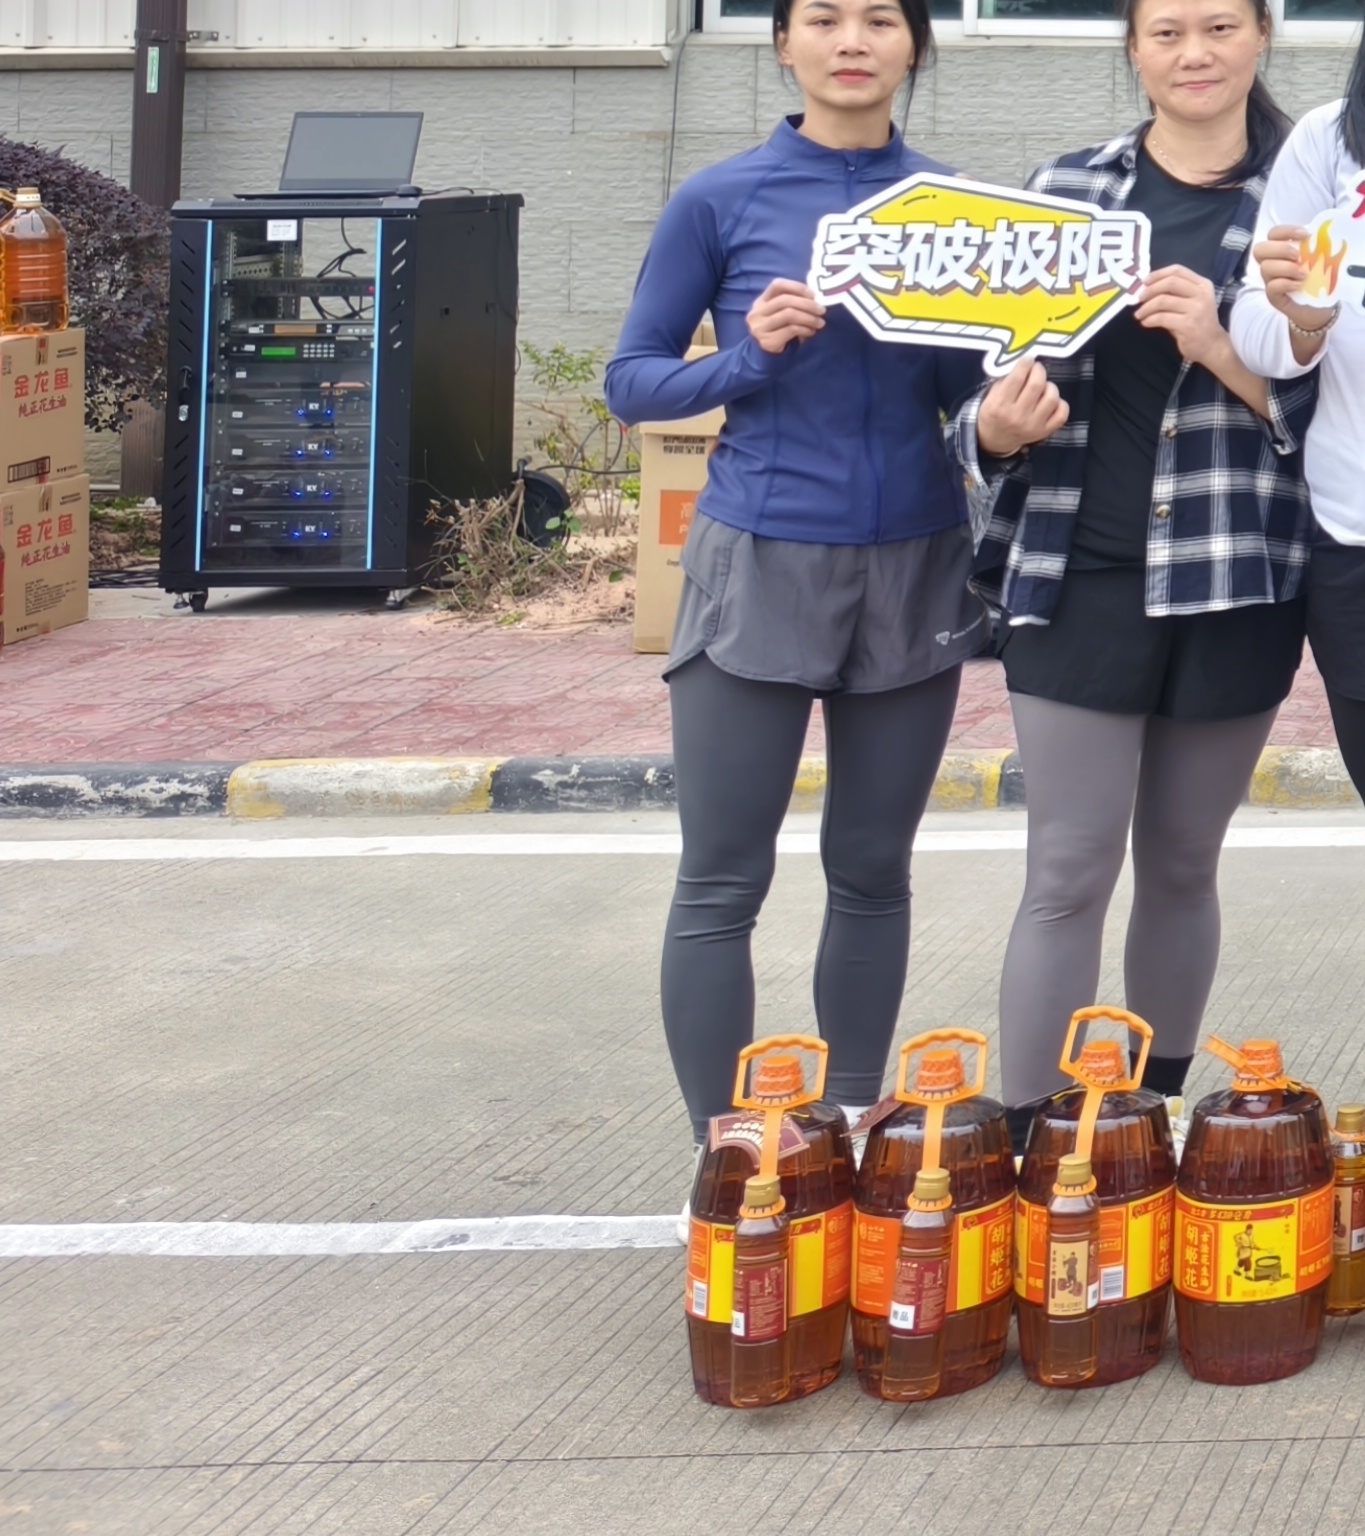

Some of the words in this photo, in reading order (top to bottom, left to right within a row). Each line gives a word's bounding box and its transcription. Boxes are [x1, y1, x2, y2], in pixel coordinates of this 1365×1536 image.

[816, 217, 1145, 296] 突破极限
[14, 367, 69, 399] 金龙鱼
[18, 395, 67, 418] 纯正花生油
[16, 513, 74, 549] 金龙鱼
[20, 541, 71, 568] 纯正花生油
[991, 1224, 1005, 1288] 胡姬花
[1185, 1225, 1198, 1288] 胡姬花
